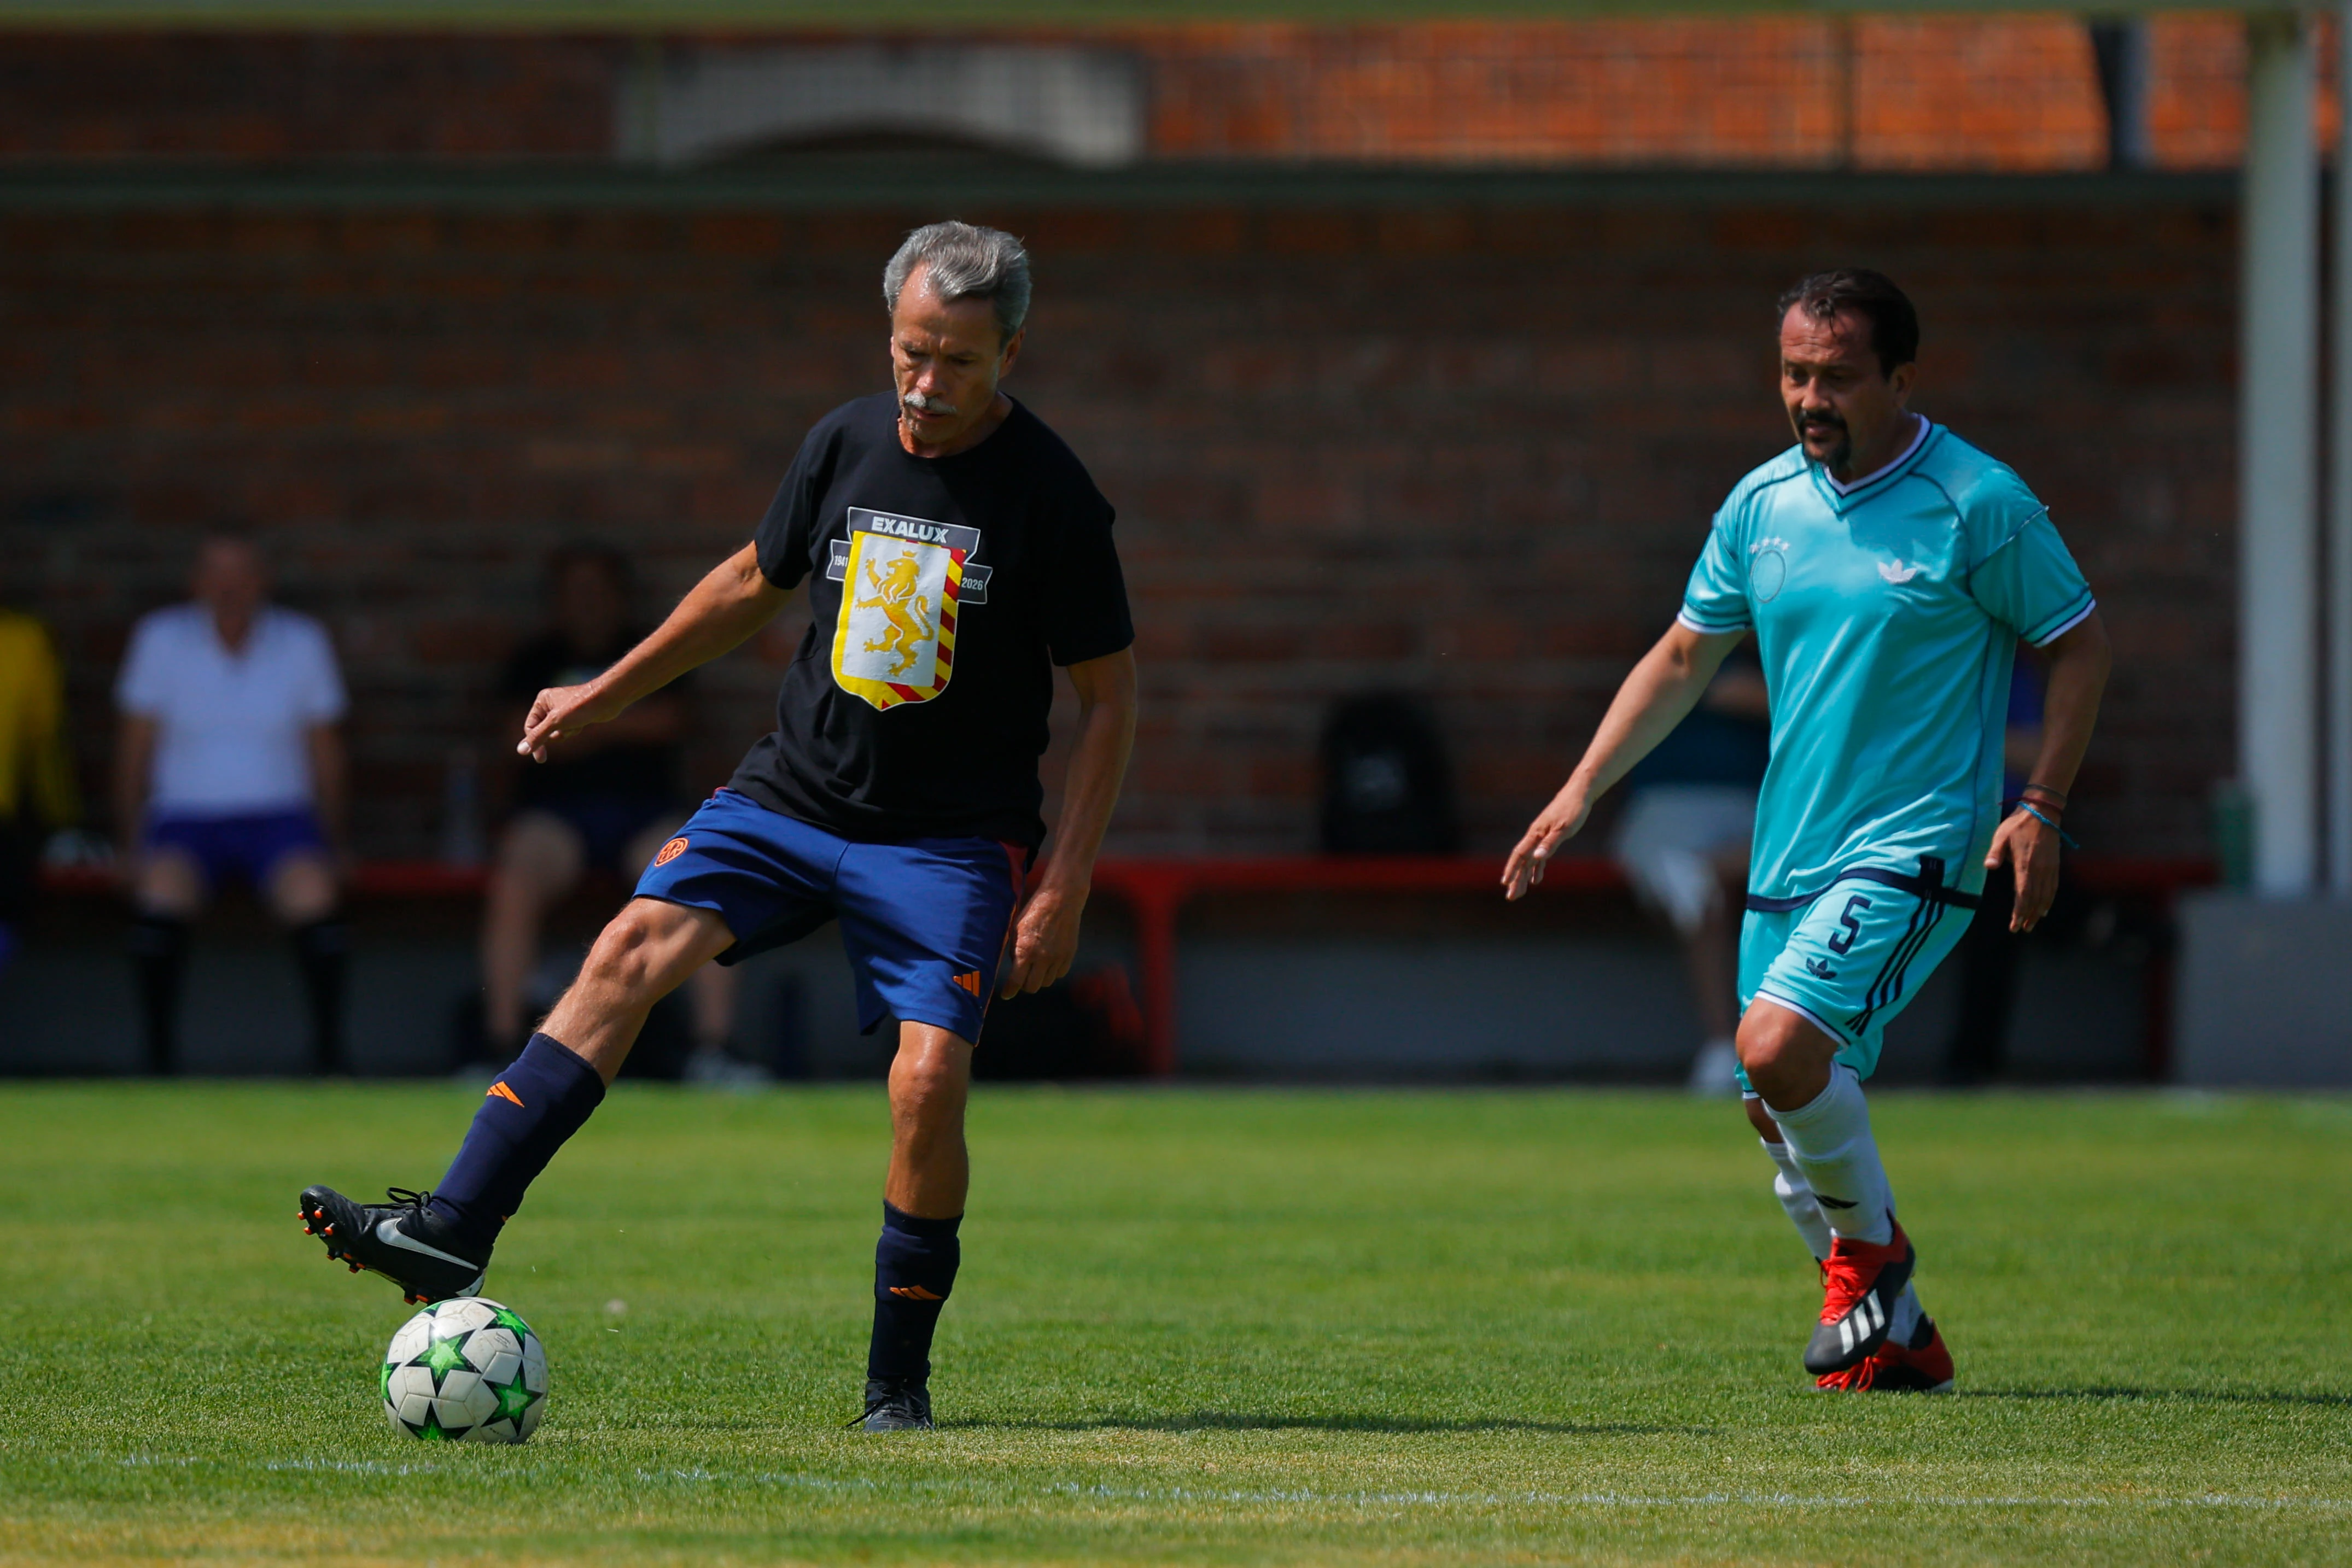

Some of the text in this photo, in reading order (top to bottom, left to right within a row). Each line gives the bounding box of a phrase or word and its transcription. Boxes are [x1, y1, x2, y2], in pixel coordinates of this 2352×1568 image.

[871, 516, 949, 543] EXALUX
[834, 555, 848, 567] 1941
[961, 577, 983, 590] 2026
[1828, 894, 1873, 955] 5
